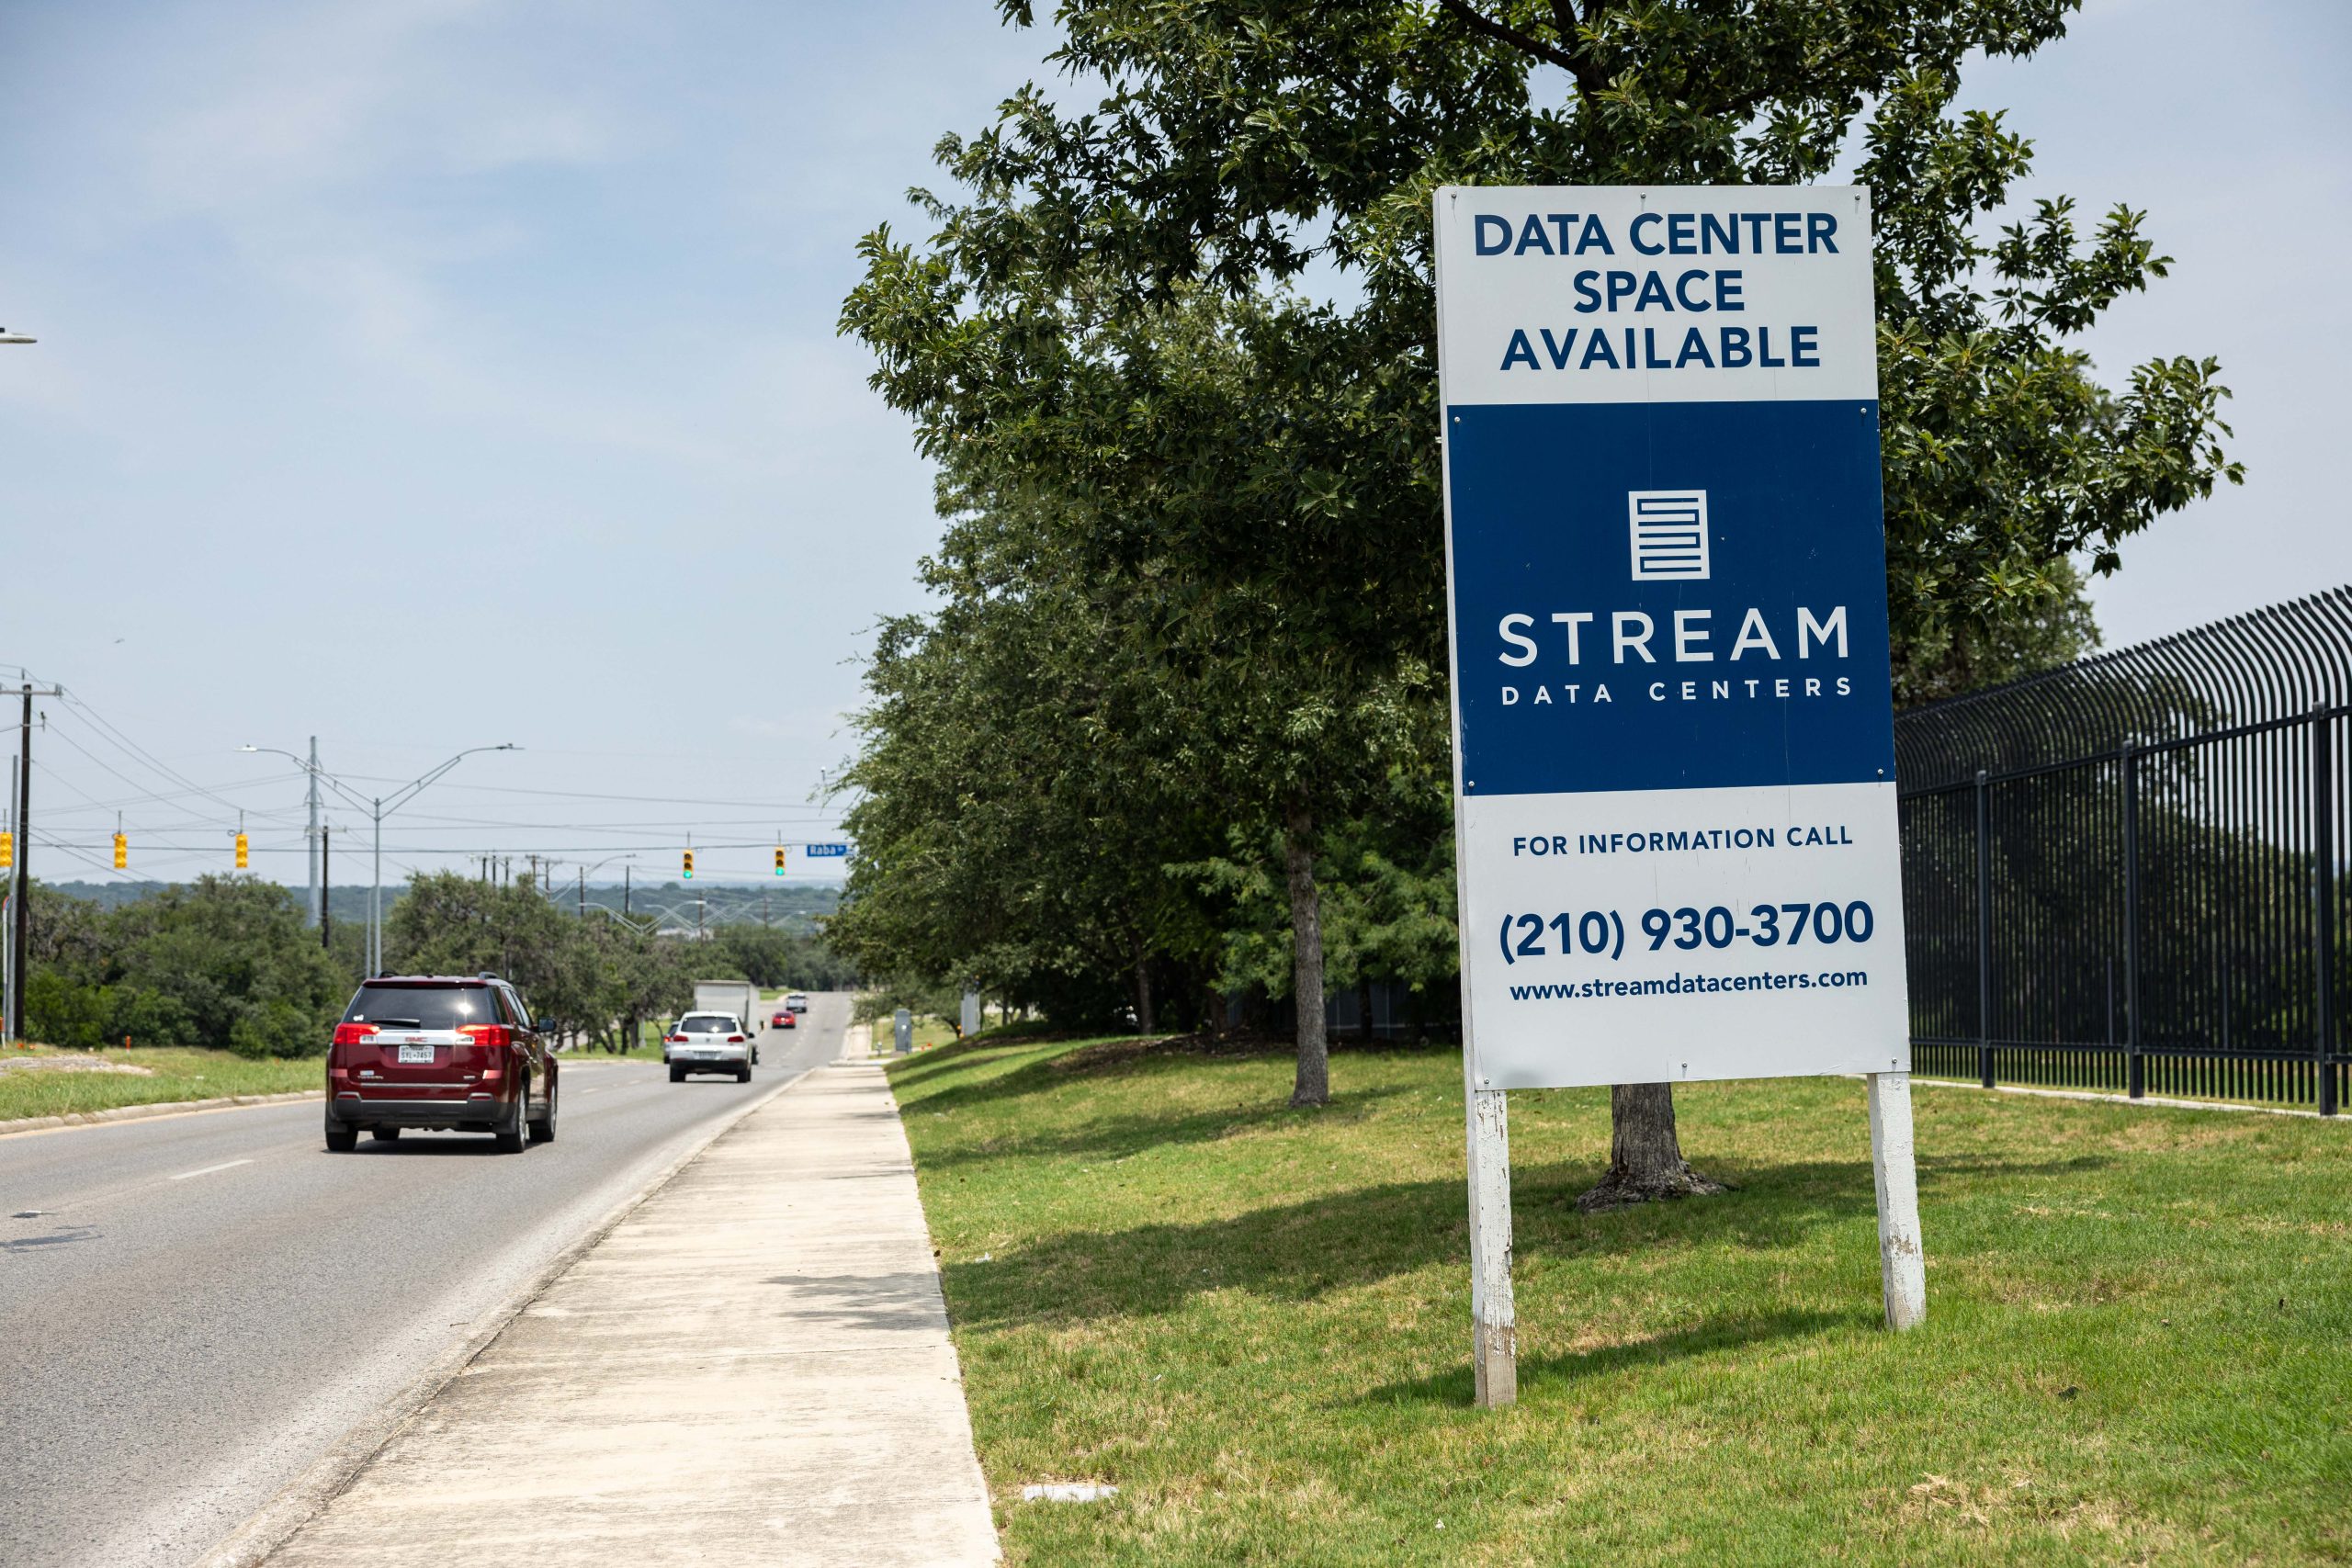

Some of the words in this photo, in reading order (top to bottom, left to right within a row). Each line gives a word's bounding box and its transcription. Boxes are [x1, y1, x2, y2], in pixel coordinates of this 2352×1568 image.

[1475, 214, 1615, 255] DATA
[1630, 213, 1839, 255] CENTER
[1574, 270, 1744, 313] SPACE
[1500, 326, 1820, 370] AVAILABLE
[1499, 606, 1849, 667] STREAM
[1502, 684, 1611, 705] DATA
[1649, 677, 1851, 702] CENTERS
[810, 846, 836, 855] Raba
[1514, 836, 1567, 856] FOR
[1580, 829, 1774, 853] INFORMATION
[1787, 826, 1853, 846] CALL
[1500, 910, 1624, 965] (210)
[1642, 900, 1873, 951] 930-3700
[1510, 971, 1867, 1000] www.streamdatacenters.com
